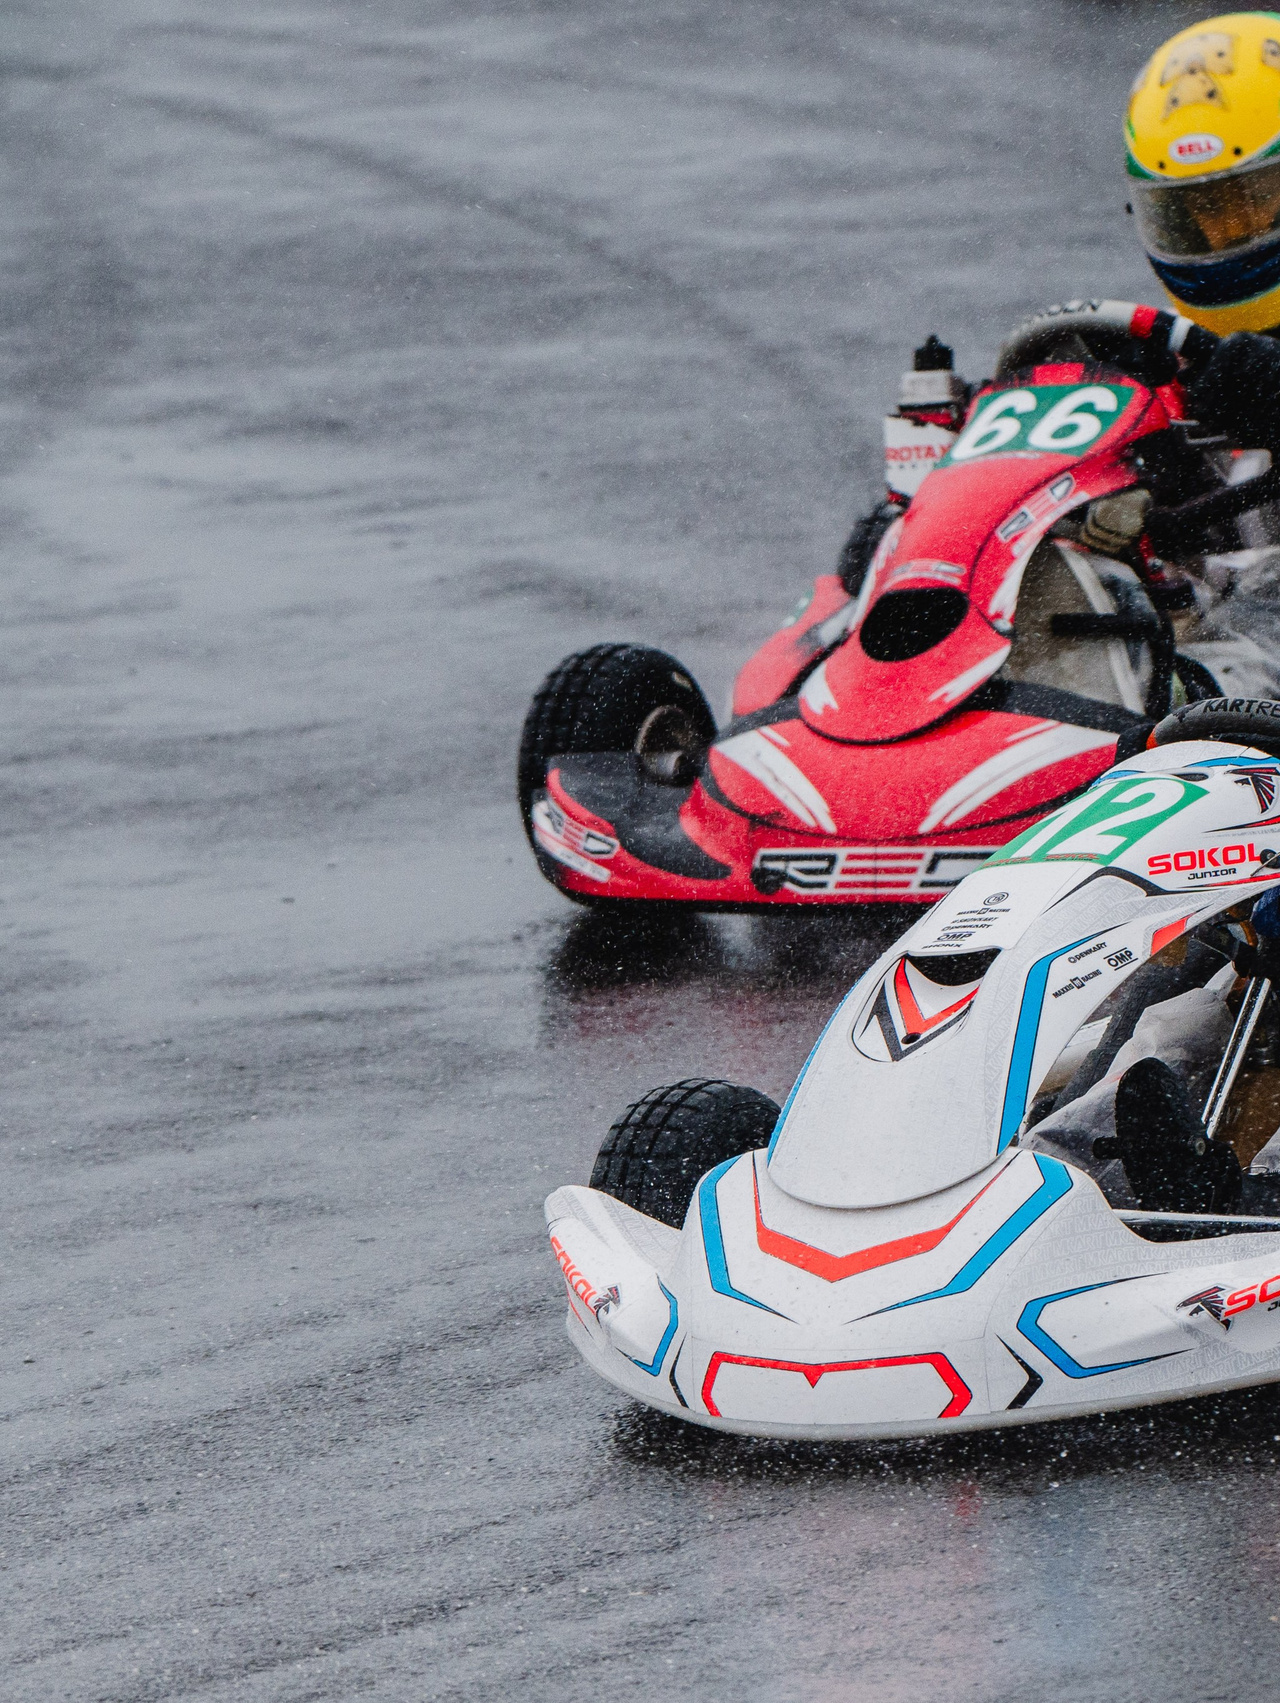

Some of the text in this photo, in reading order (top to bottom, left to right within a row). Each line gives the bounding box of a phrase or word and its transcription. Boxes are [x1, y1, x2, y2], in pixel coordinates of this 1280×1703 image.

[1176, 142, 1213, 156] BELL
[952, 385, 1118, 461] 66
[1009, 778, 1186, 859] 12
[1147, 842, 1262, 876] SOKOL
[1187, 867, 1237, 881] JUNIOR
[936, 933, 973, 941] OMP
[1107, 949, 1134, 968] OMP
[1080, 968, 1103, 983] RACING
